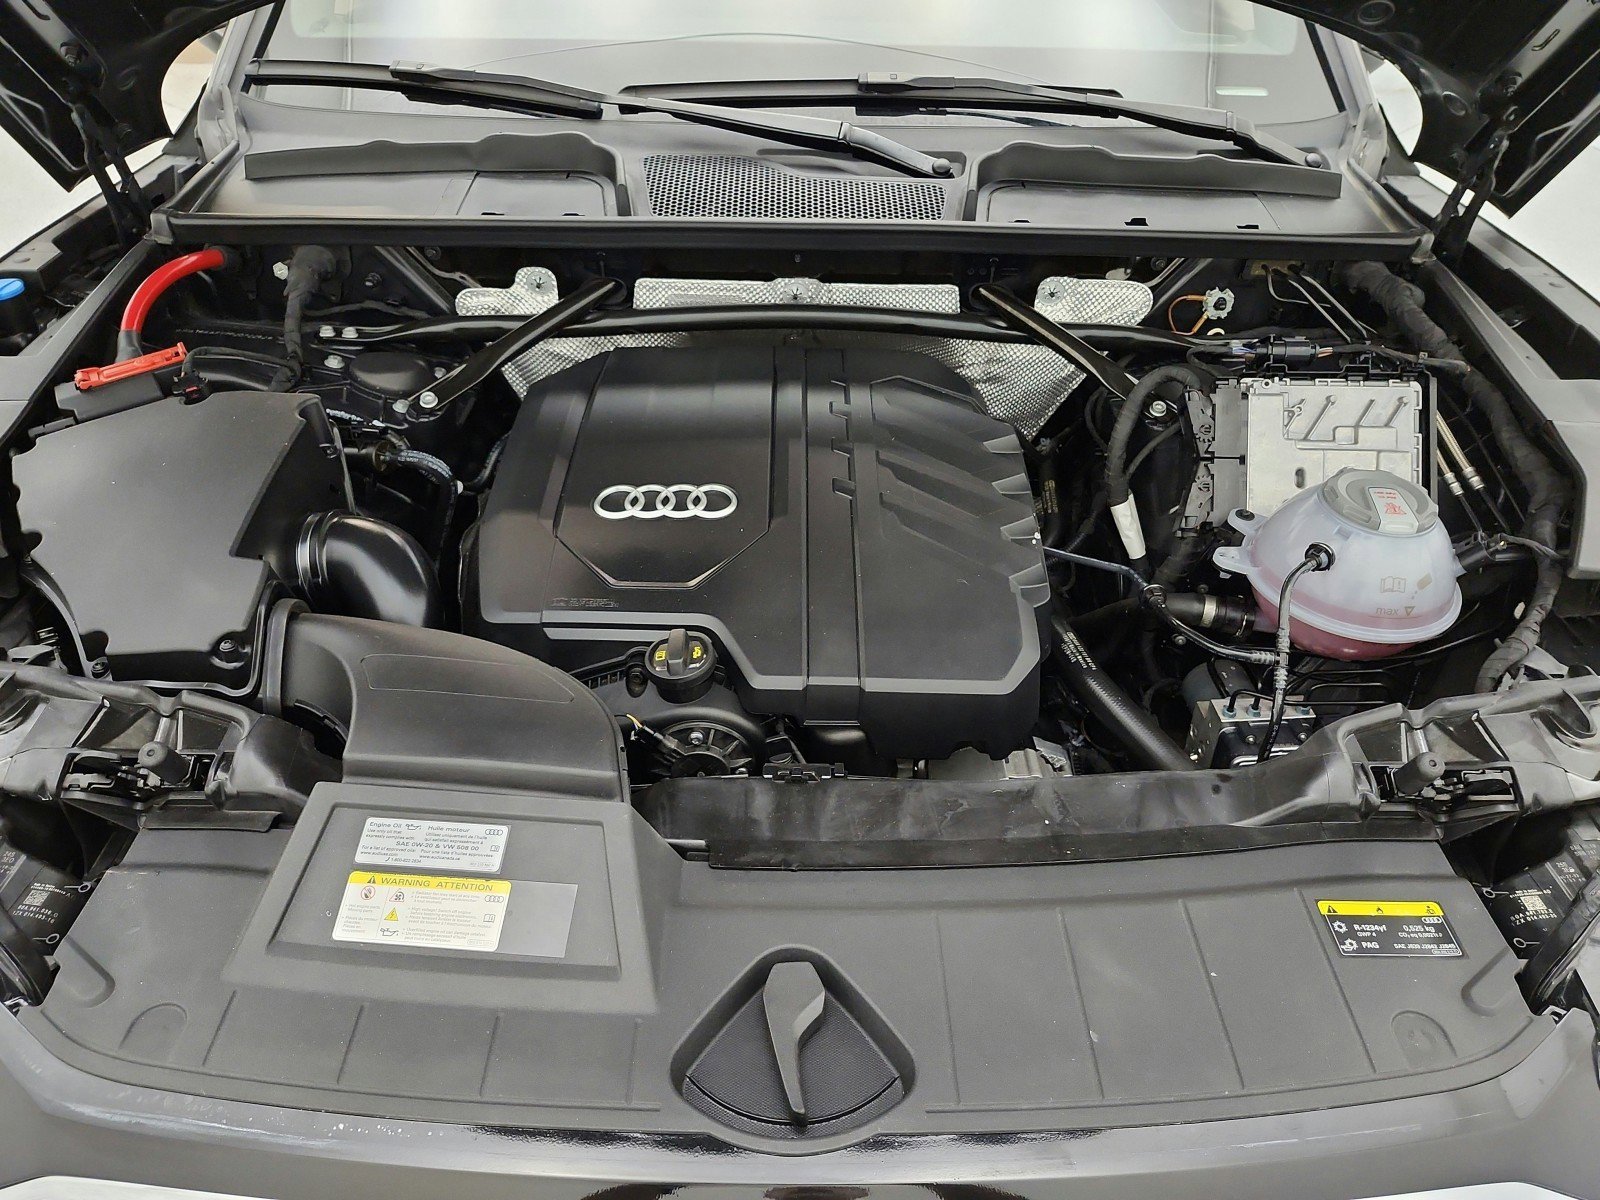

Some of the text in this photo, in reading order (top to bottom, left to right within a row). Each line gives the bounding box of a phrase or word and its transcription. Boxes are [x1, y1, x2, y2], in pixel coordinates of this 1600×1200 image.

[1376, 607, 1399, 616] max
[381, 877, 493, 891] WARNING ATTENTION
[1353, 924, 1387, 932] R-1234yf
